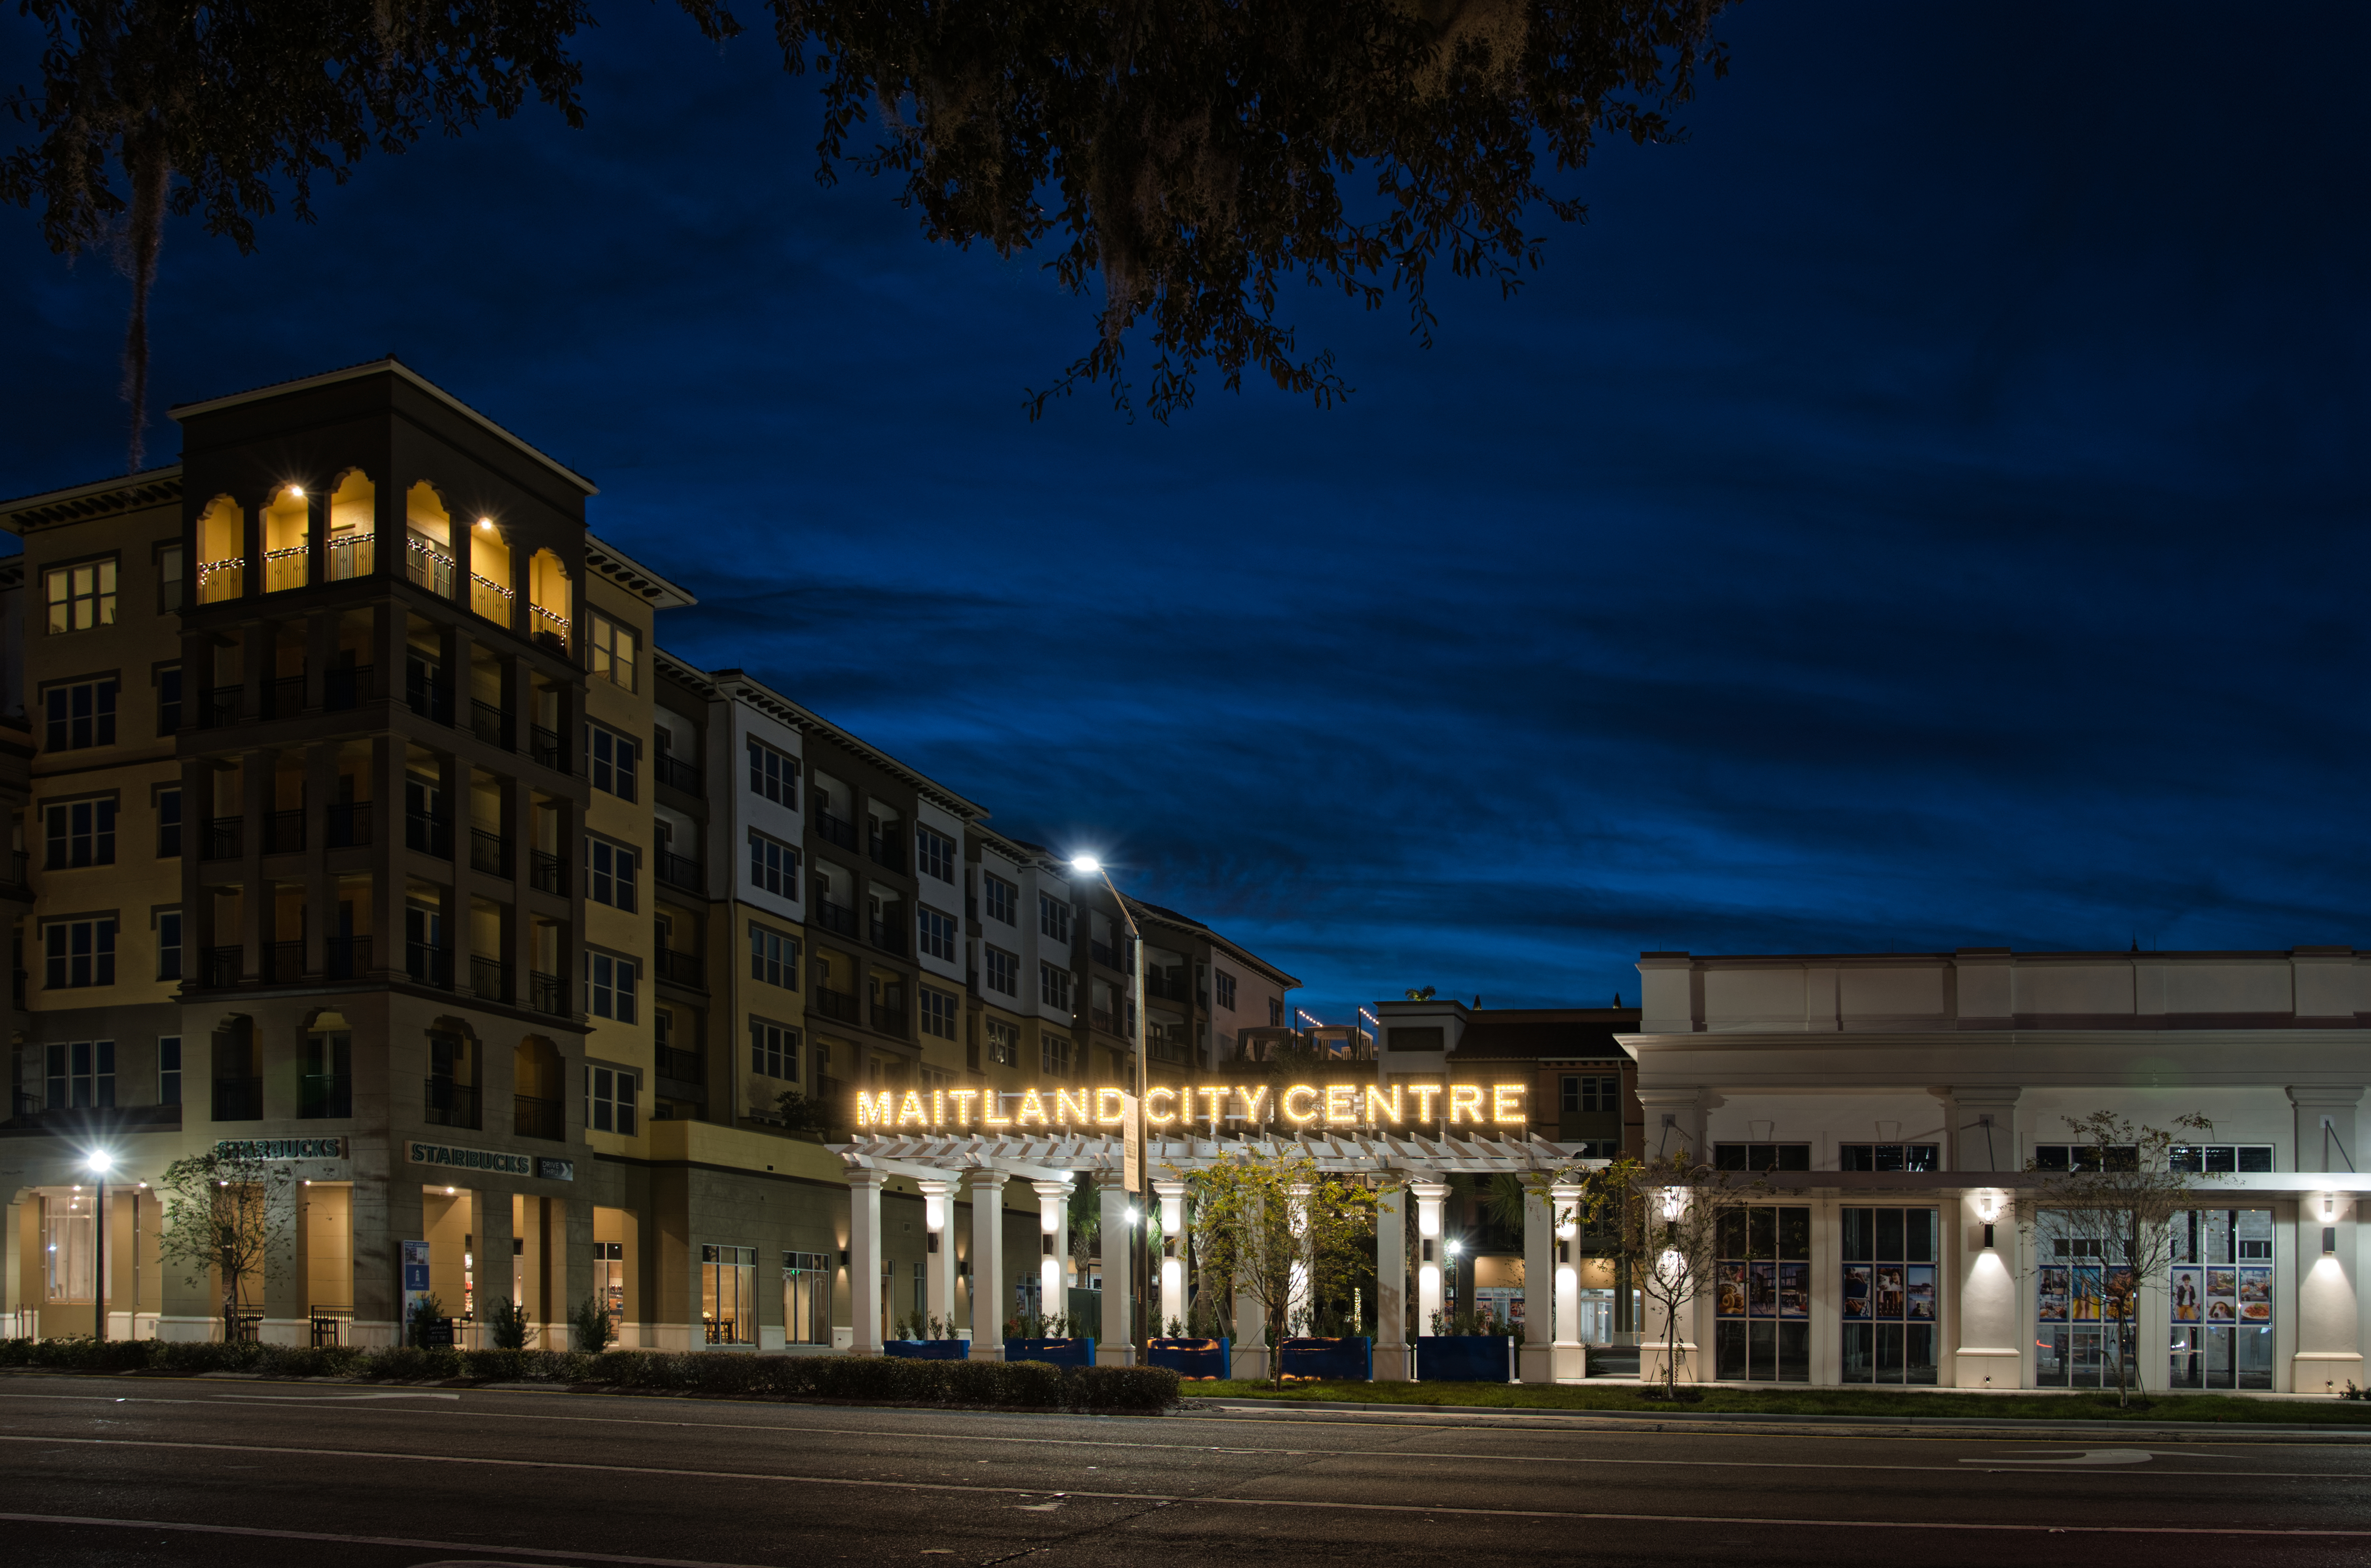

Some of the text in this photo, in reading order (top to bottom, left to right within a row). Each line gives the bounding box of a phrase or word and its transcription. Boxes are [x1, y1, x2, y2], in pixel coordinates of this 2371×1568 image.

[856, 1083, 1526, 1125] MAITLAND CITY CENTRE
[218, 1139, 337, 1158] STARBUCKS
[413, 1143, 530, 1174] STARBUCKS
[542, 1161, 559, 1169] DRIVE
